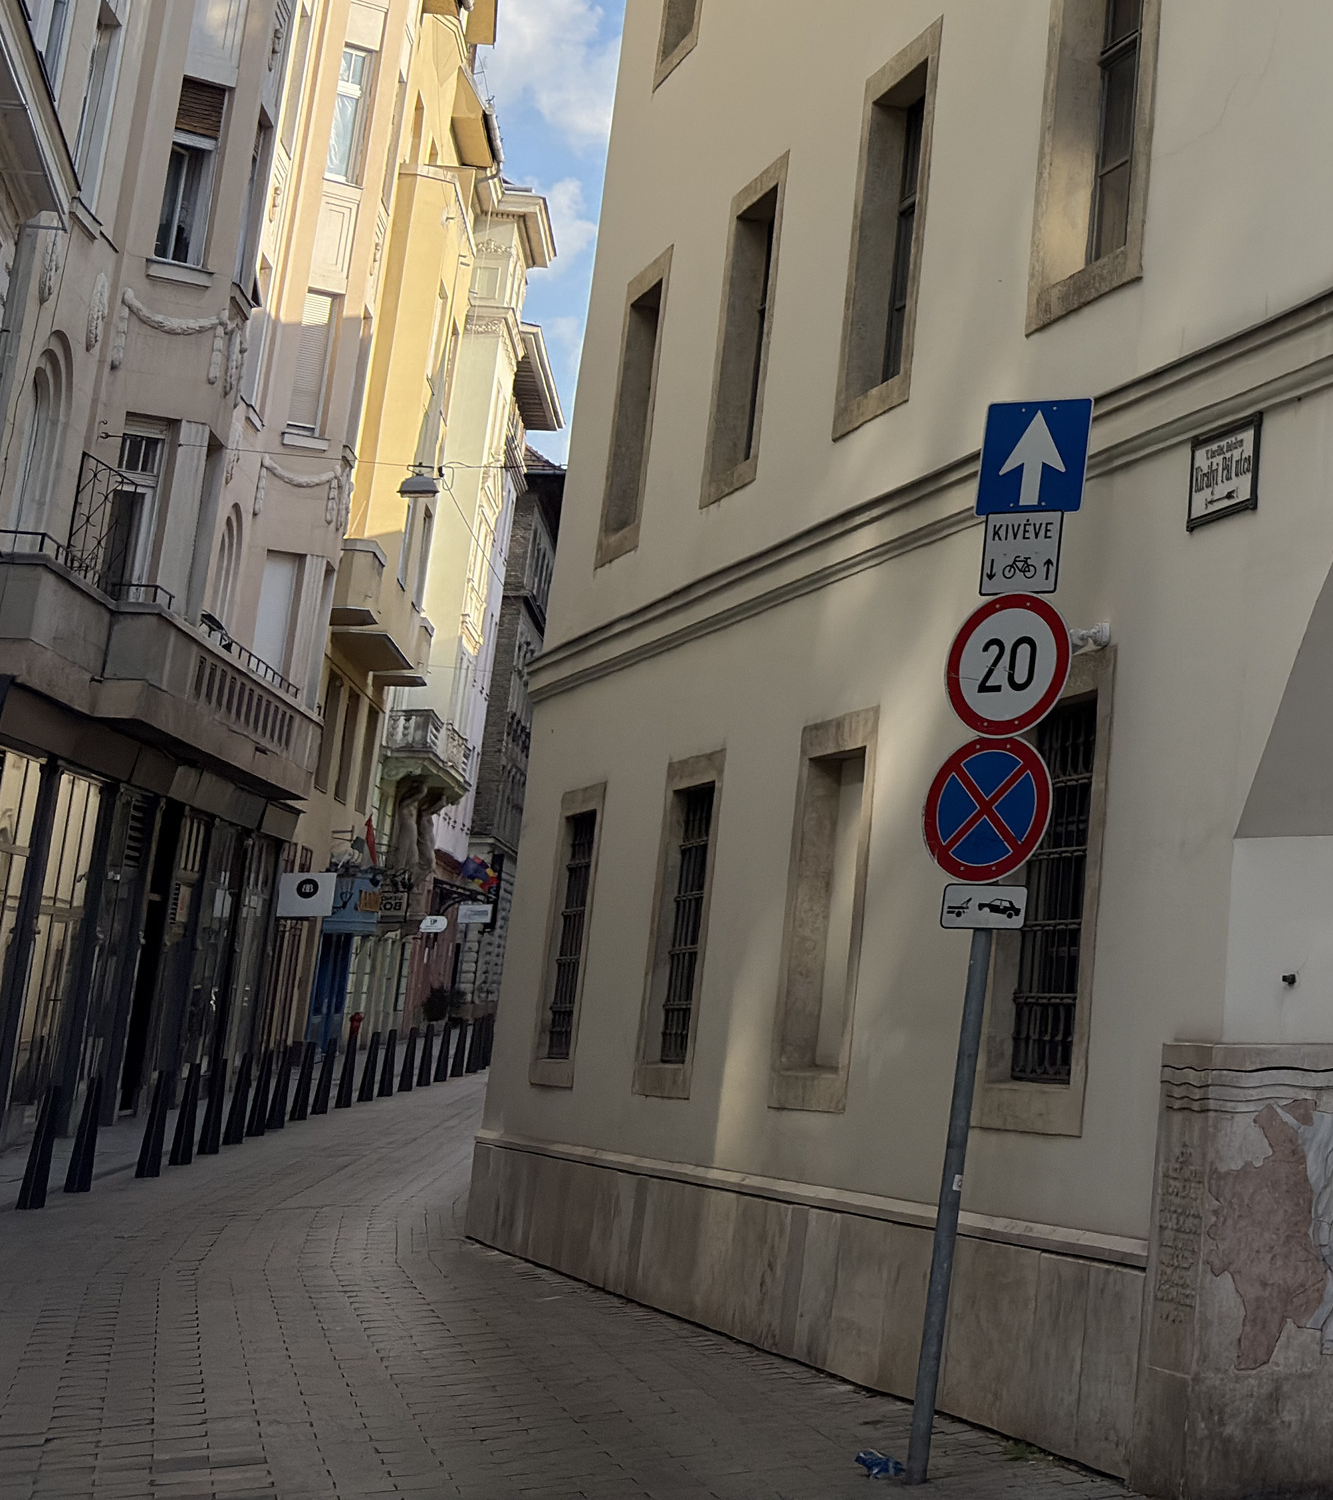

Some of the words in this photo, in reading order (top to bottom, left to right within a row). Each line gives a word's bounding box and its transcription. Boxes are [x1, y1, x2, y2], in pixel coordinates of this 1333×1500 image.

[1194, 461, 1219, 496] Királyi
[1221, 453, 1233, 483] Pál
[1235, 448, 1252, 477] utca
[992, 518, 1054, 542] KIVÉVE
[977, 636, 1037, 693] 20
